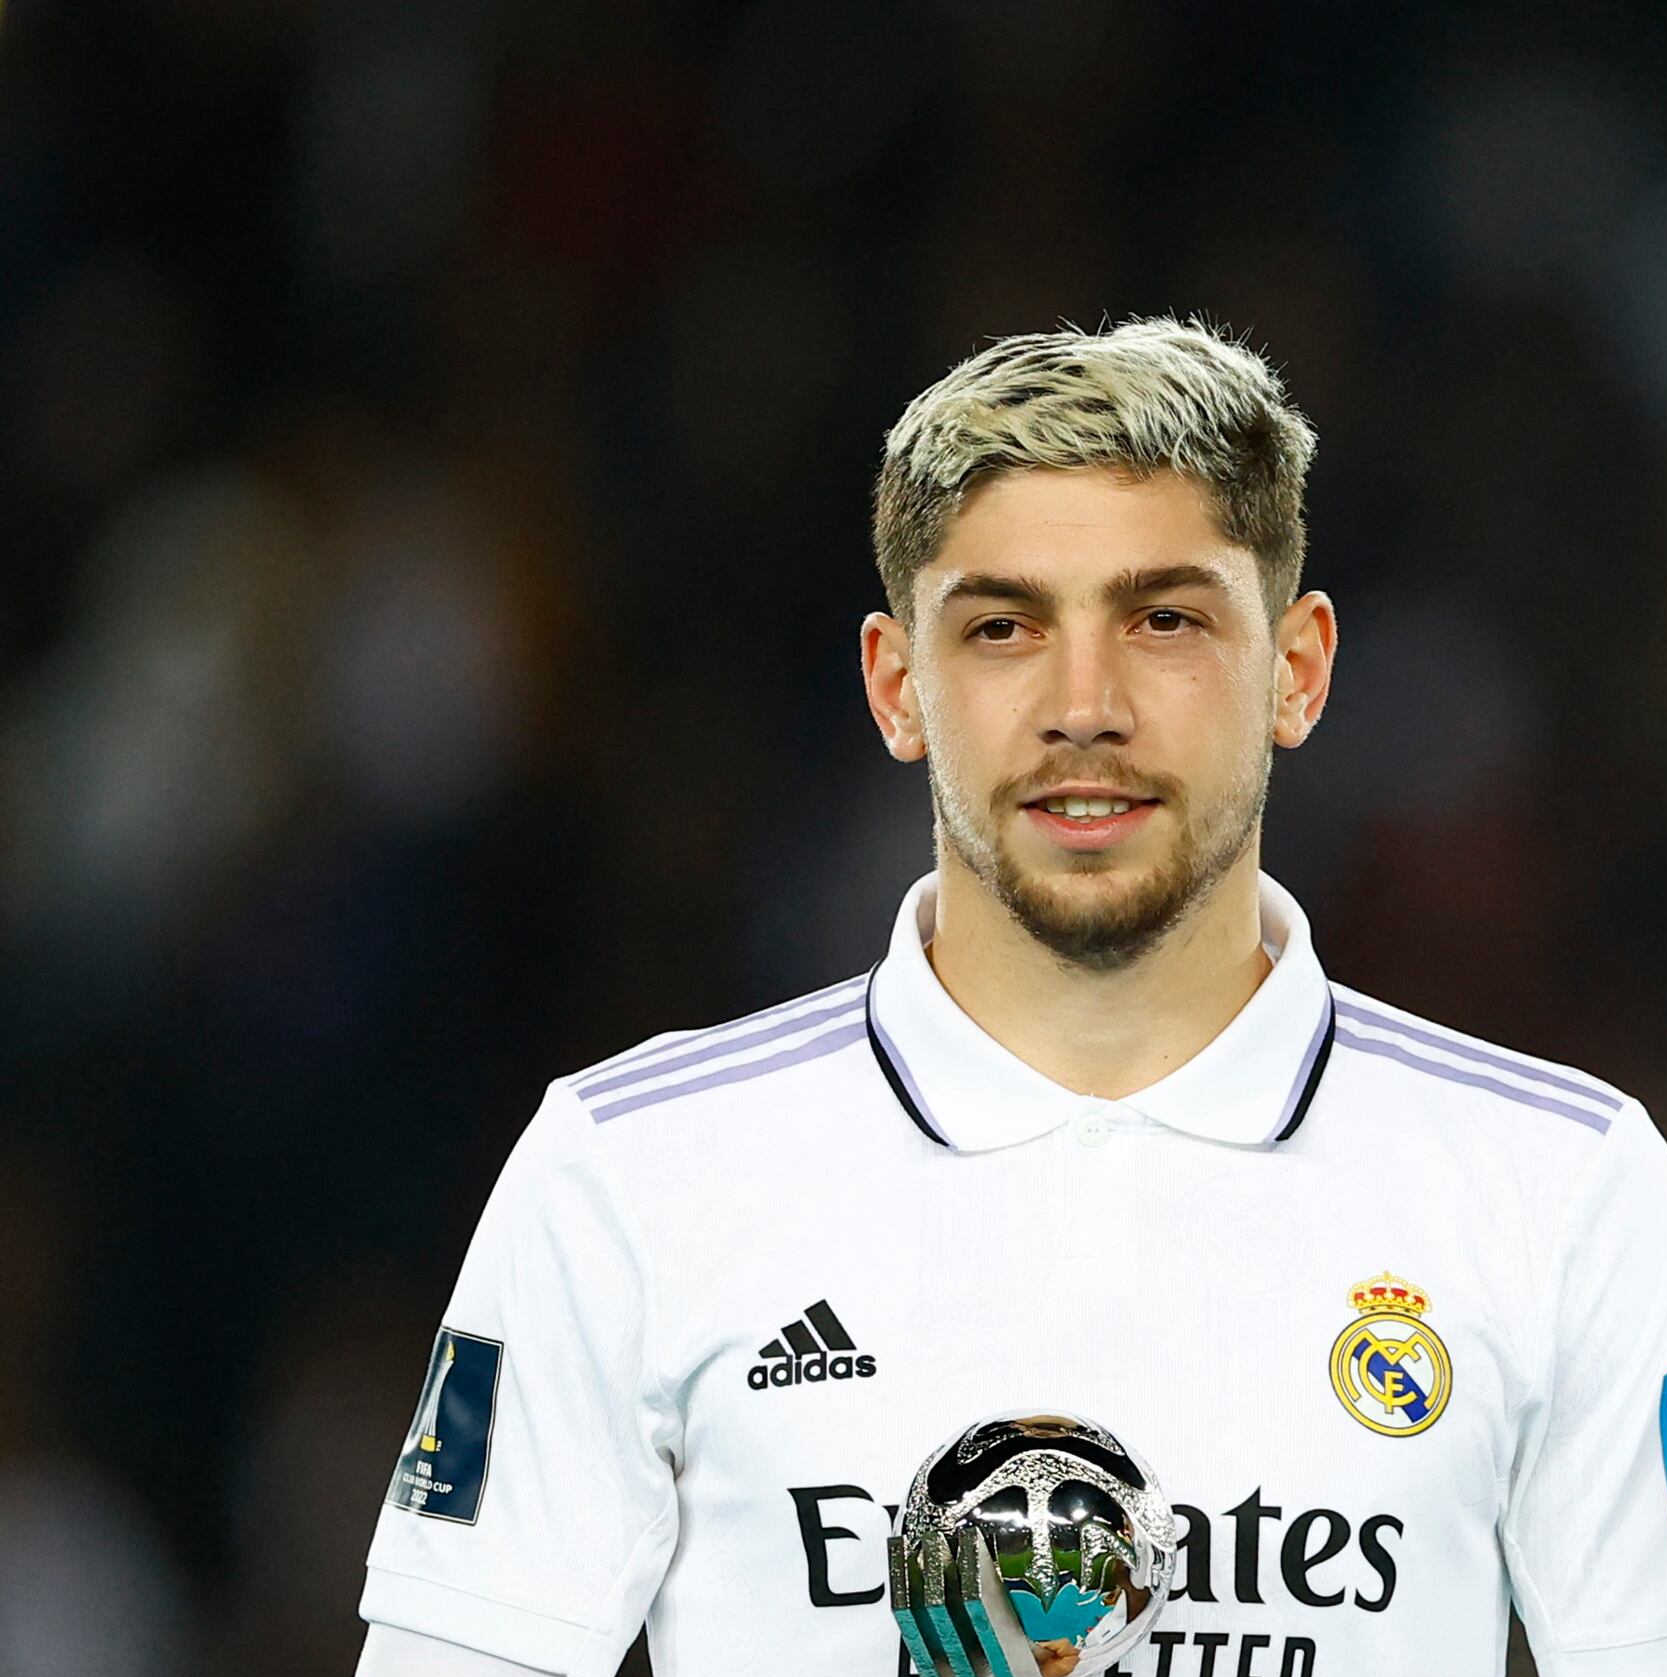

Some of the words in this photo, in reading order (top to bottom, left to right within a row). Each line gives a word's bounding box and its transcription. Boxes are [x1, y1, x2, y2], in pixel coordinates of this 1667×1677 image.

[747, 1351, 877, 1390] adidas
[433, 1481, 454, 1494] CUP
[788, 1484, 1404, 1612] Eates
